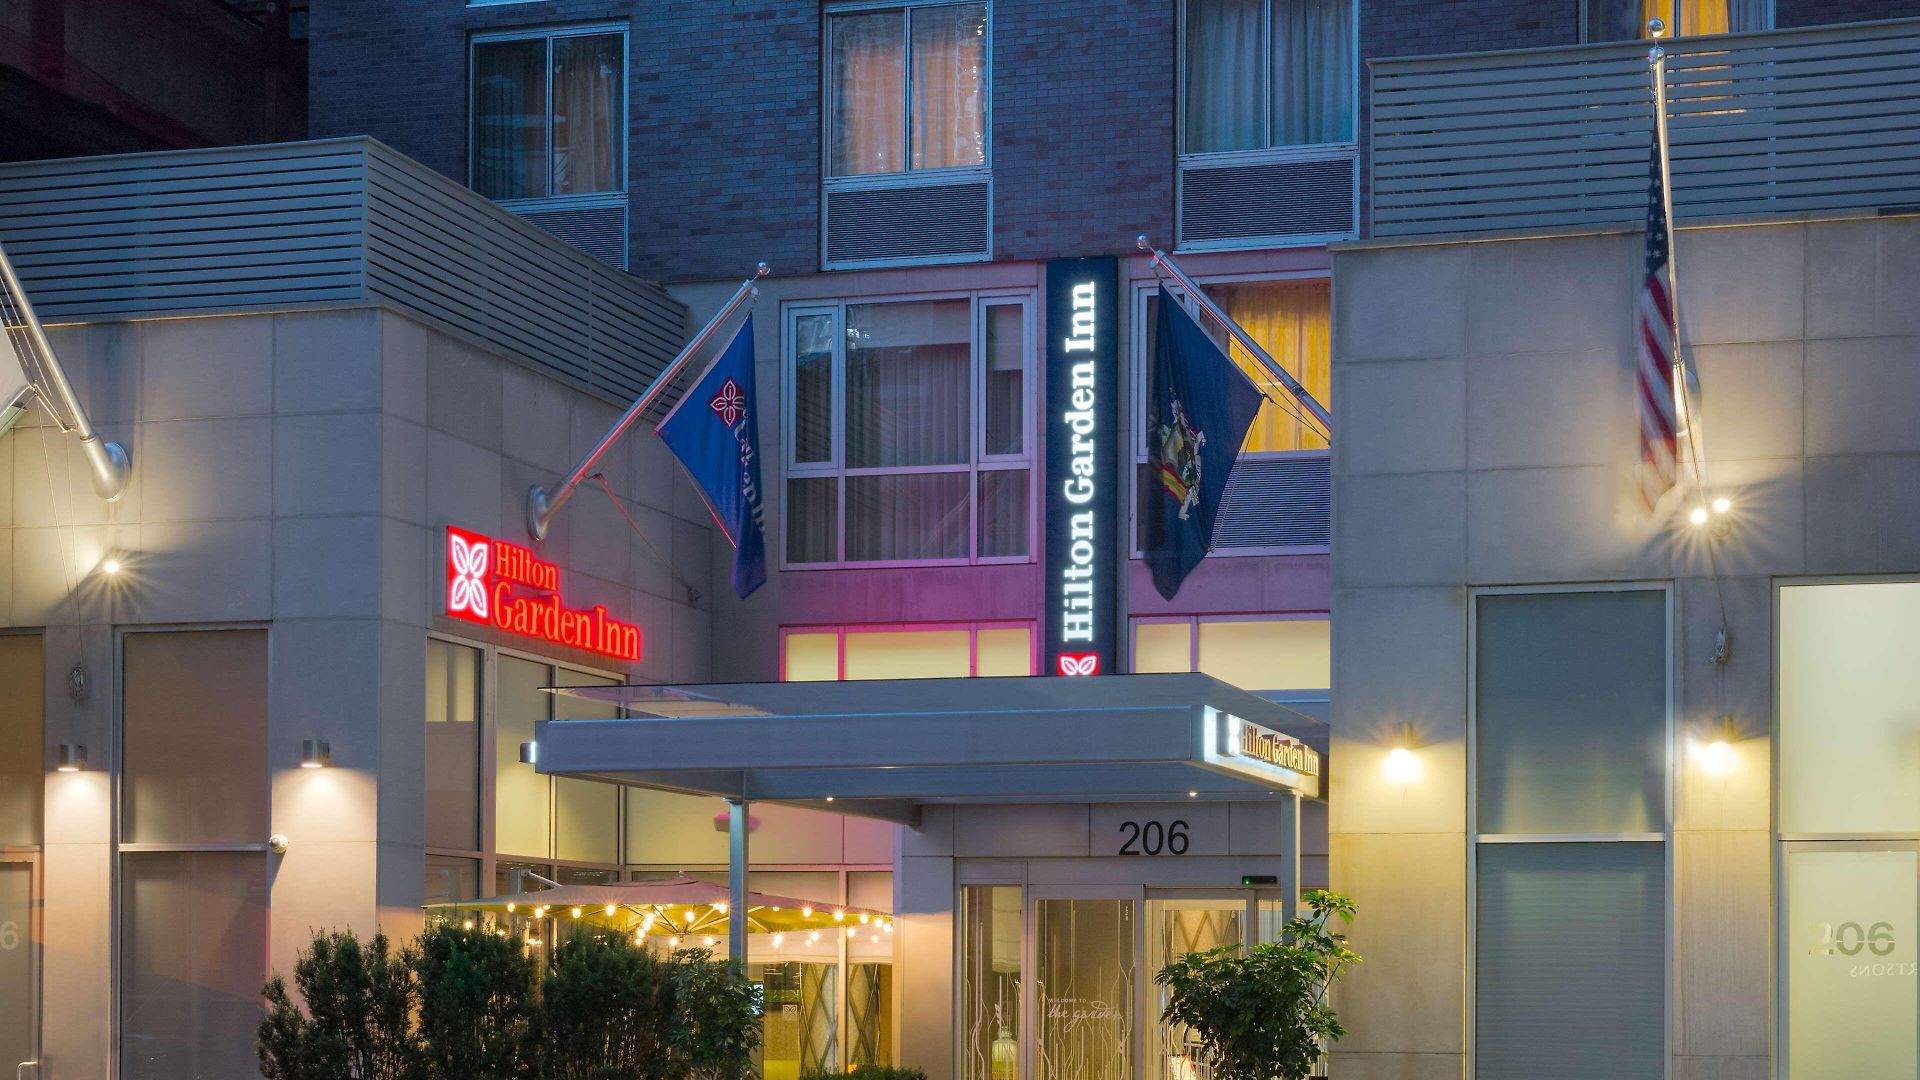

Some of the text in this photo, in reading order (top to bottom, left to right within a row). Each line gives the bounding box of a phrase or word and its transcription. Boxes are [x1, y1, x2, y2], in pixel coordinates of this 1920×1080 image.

[1064, 281, 1096, 642] Hilton Garden Inn
[494, 541, 559, 591] Hilton
[494, 581, 640, 660] Garden Inn
[1272, 734, 1304, 773] Garden
[1303, 743, 1319, 777] Inn
[1119, 820, 1189, 856] 206
[1047, 1004, 1070, 1018] the
